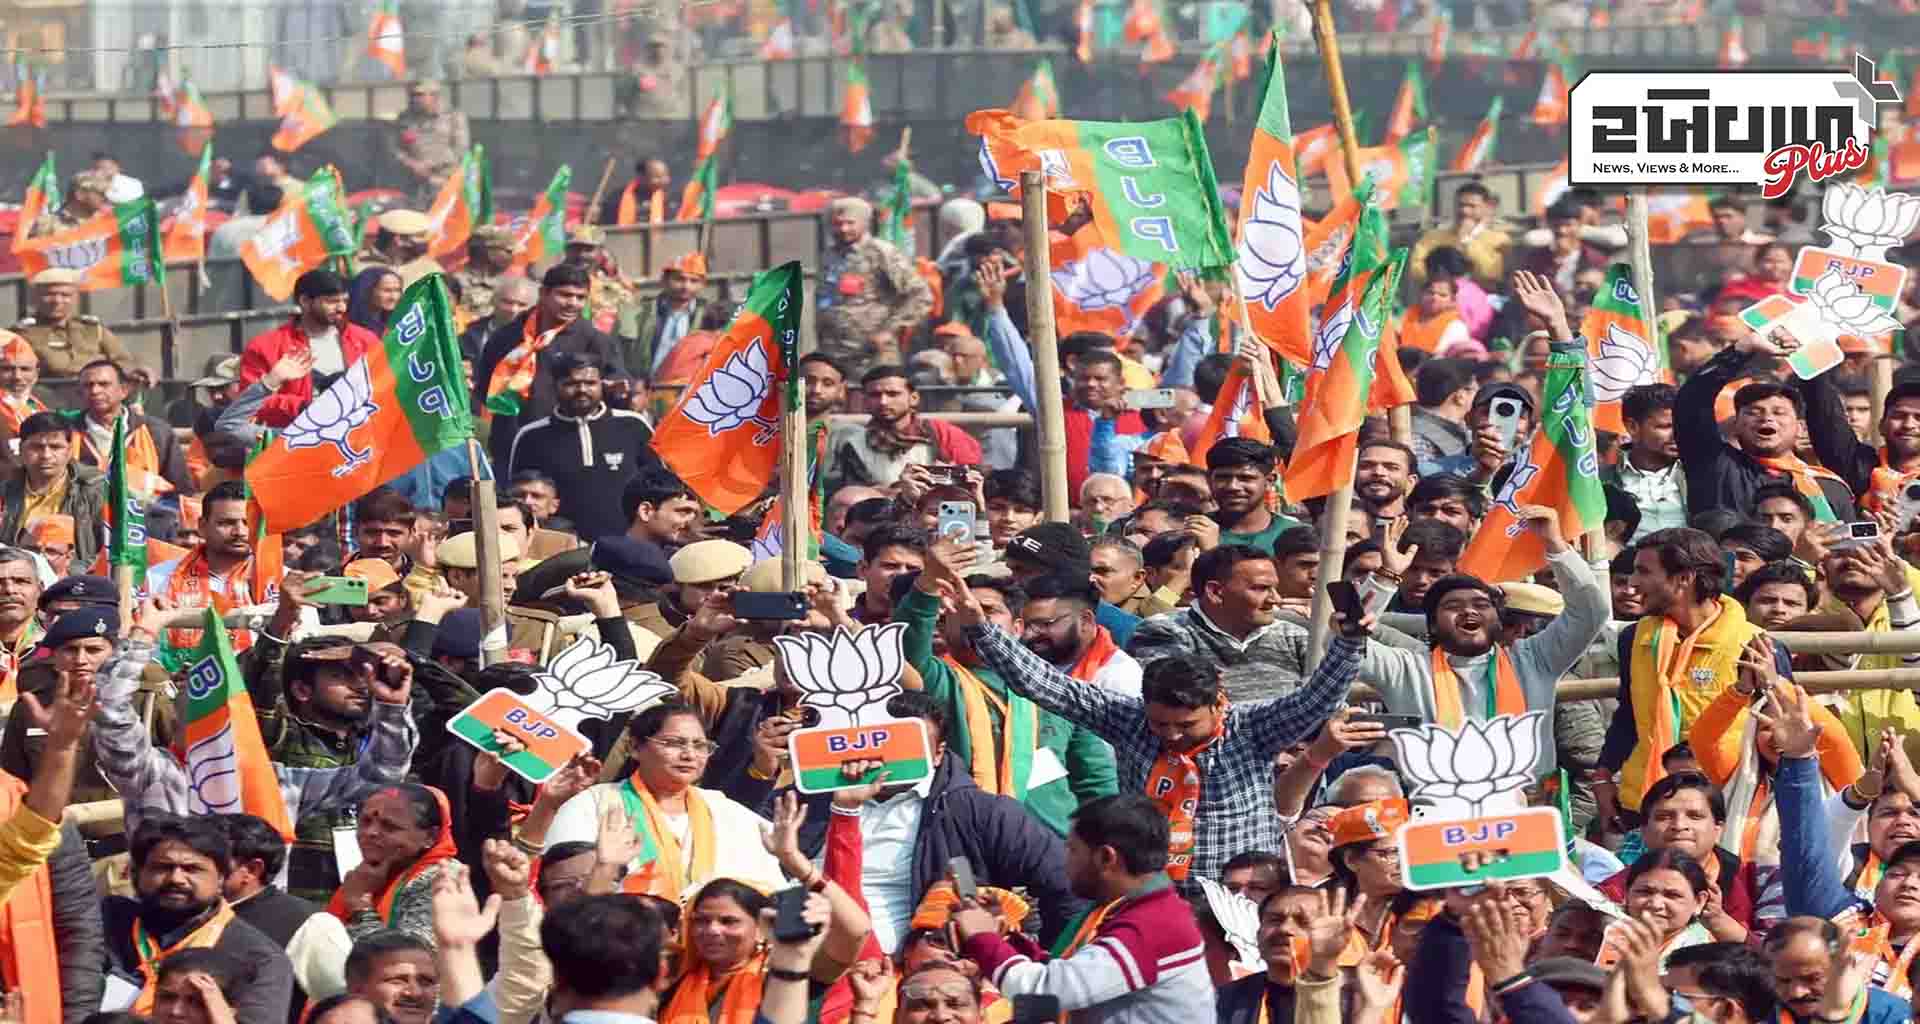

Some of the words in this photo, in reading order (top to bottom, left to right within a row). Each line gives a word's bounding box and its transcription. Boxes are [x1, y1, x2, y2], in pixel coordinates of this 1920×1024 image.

[505, 707, 559, 739] BJP
[827, 730, 889, 752] BJP
[1444, 820, 1516, 844] BJP
